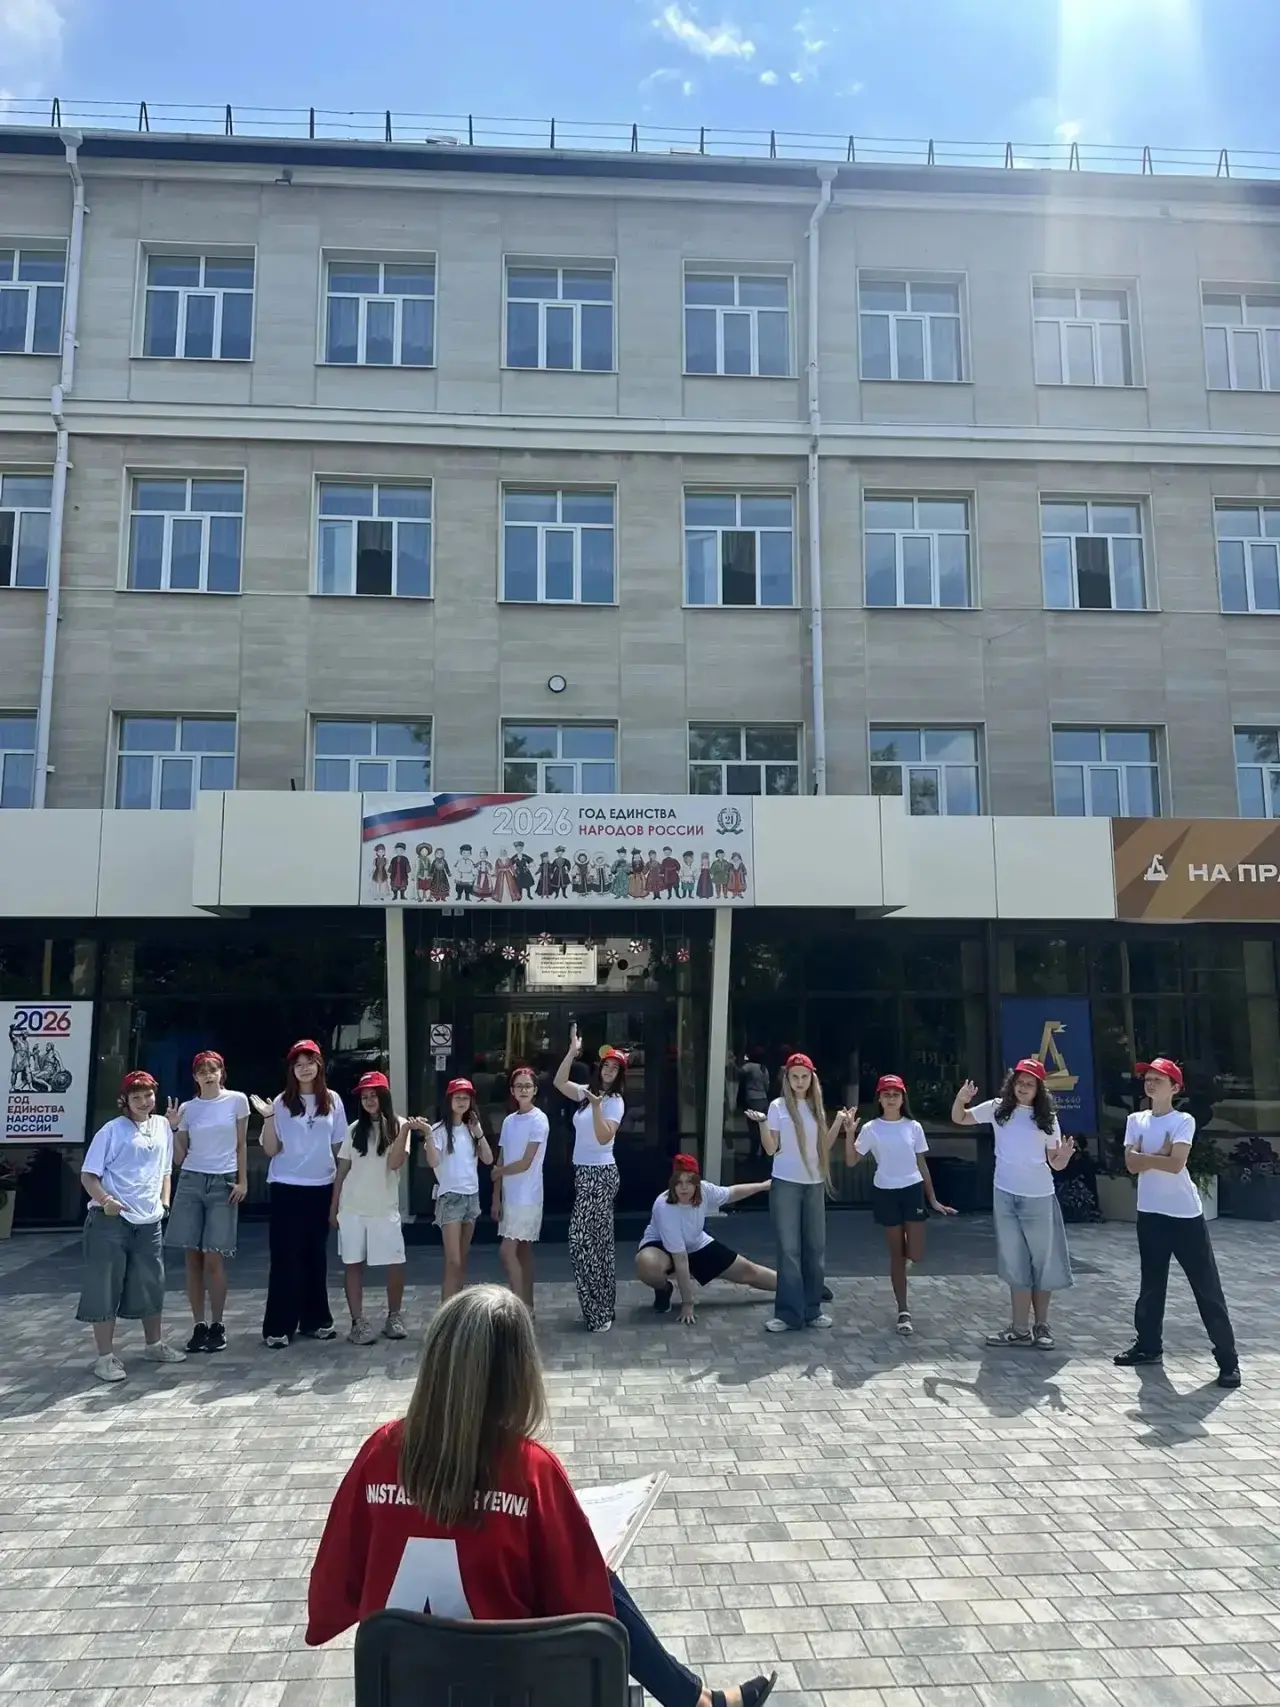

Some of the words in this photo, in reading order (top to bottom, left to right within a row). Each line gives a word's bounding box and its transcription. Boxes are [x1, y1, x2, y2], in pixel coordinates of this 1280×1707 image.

[579, 808, 606, 821] ГОД
[609, 808, 677, 821] ЕДИНСТВА
[492, 807, 573, 836] 2026
[579, 825, 644, 837] НАРОДОВ
[648, 825, 704, 836] РОССИИ
[1188, 863, 1231, 882] НА
[1238, 864, 1280, 882] ПР
[13, 1010, 71, 1031] 2026
[8, 1096, 30, 1105] ГОД
[7, 1105, 65, 1114] ЕДИНСТВА
[6, 1114, 59, 1124] НАРОДОВ
[6, 1124, 52, 1132] РОССИИ
